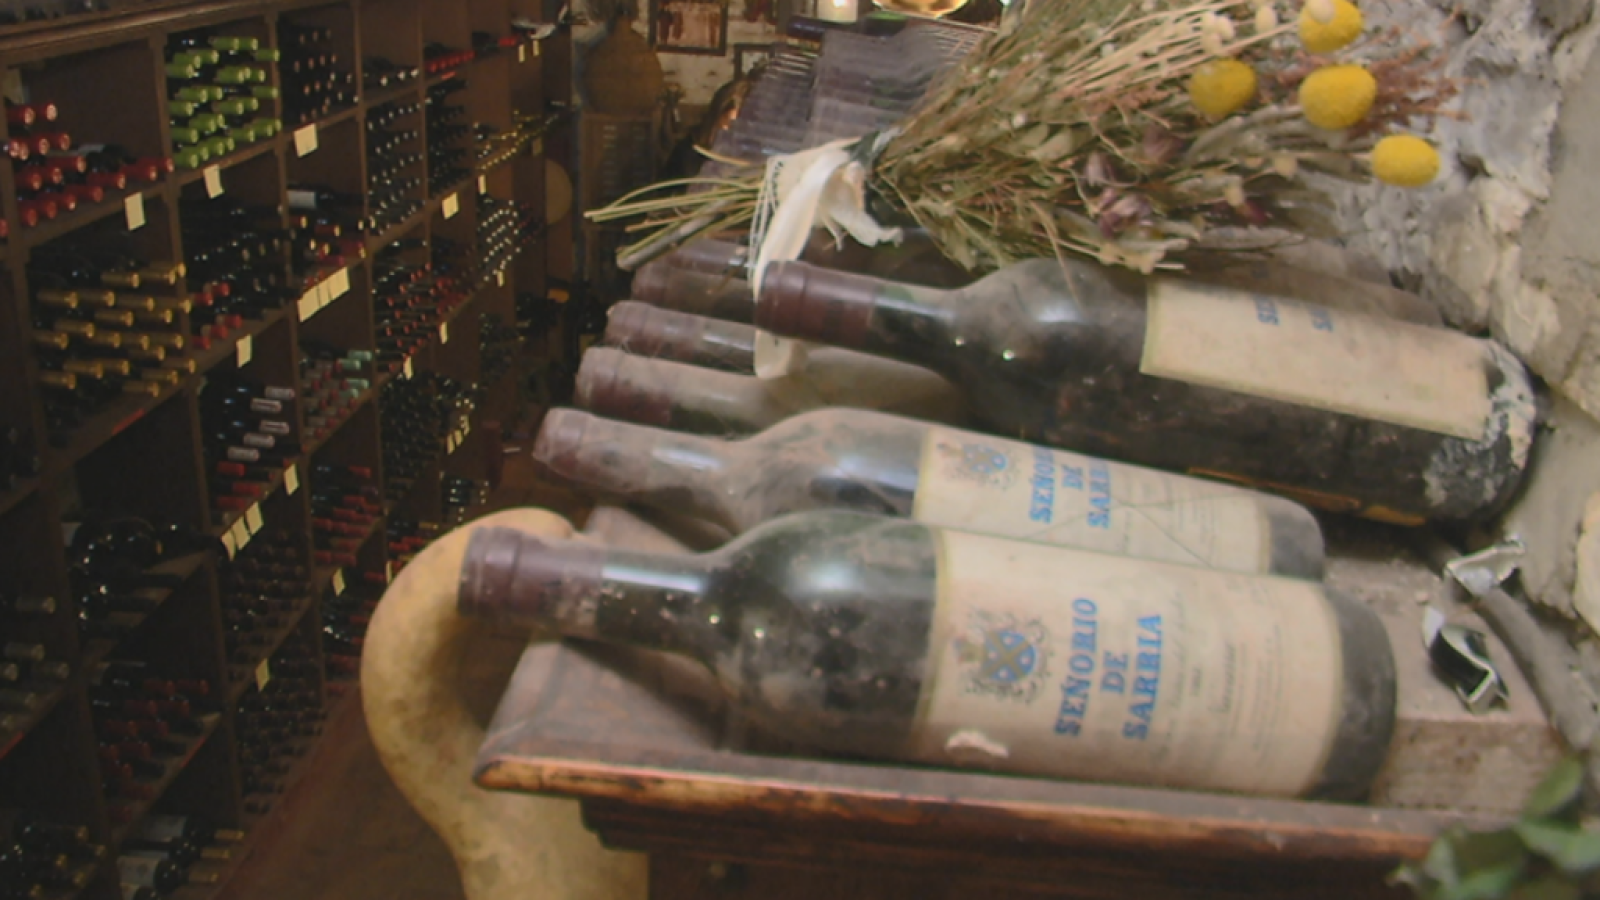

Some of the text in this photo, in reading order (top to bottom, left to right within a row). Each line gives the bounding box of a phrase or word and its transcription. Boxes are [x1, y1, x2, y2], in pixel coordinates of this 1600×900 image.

[1061, 464, 1084, 490] DE
[1101, 650, 1128, 695] DE
[1122, 614, 1162, 741] SARRIA
